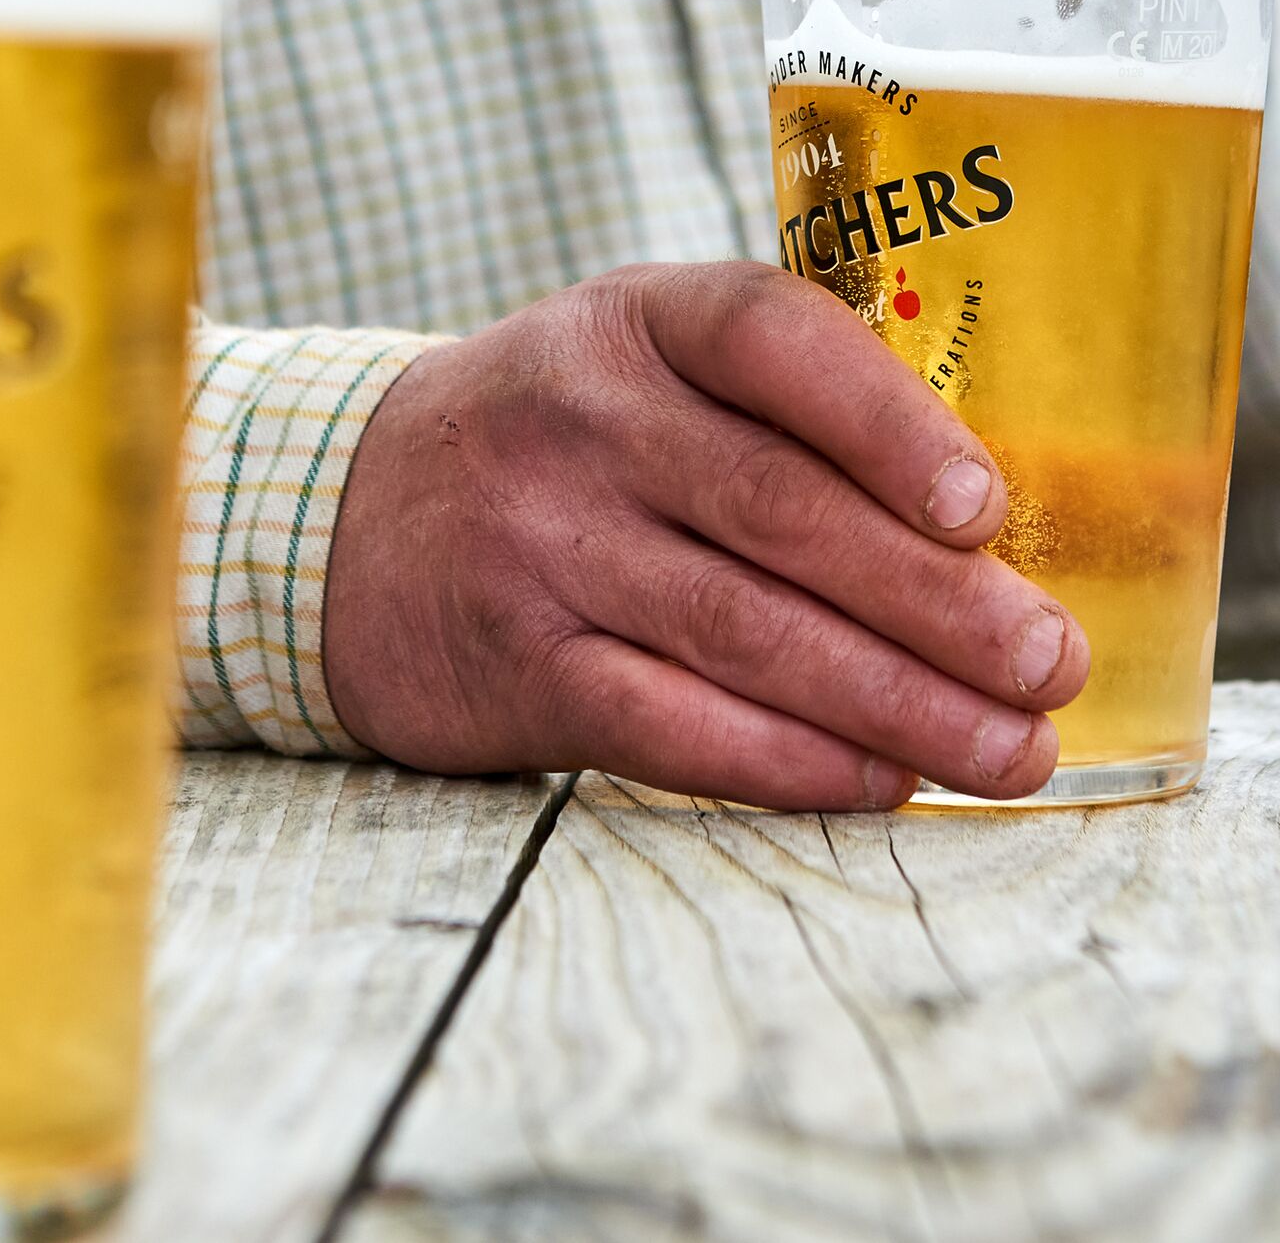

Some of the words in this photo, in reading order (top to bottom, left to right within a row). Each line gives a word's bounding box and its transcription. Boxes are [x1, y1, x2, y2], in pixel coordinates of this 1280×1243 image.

[1163, 35, 1183, 58] M
[1188, 35, 1213, 58] 20
[770, 50, 807, 93] CIDER
[818, 50, 918, 116] MAKERS
[779, 101, 818, 133] SINCE
[778, 133, 845, 193] 1904
